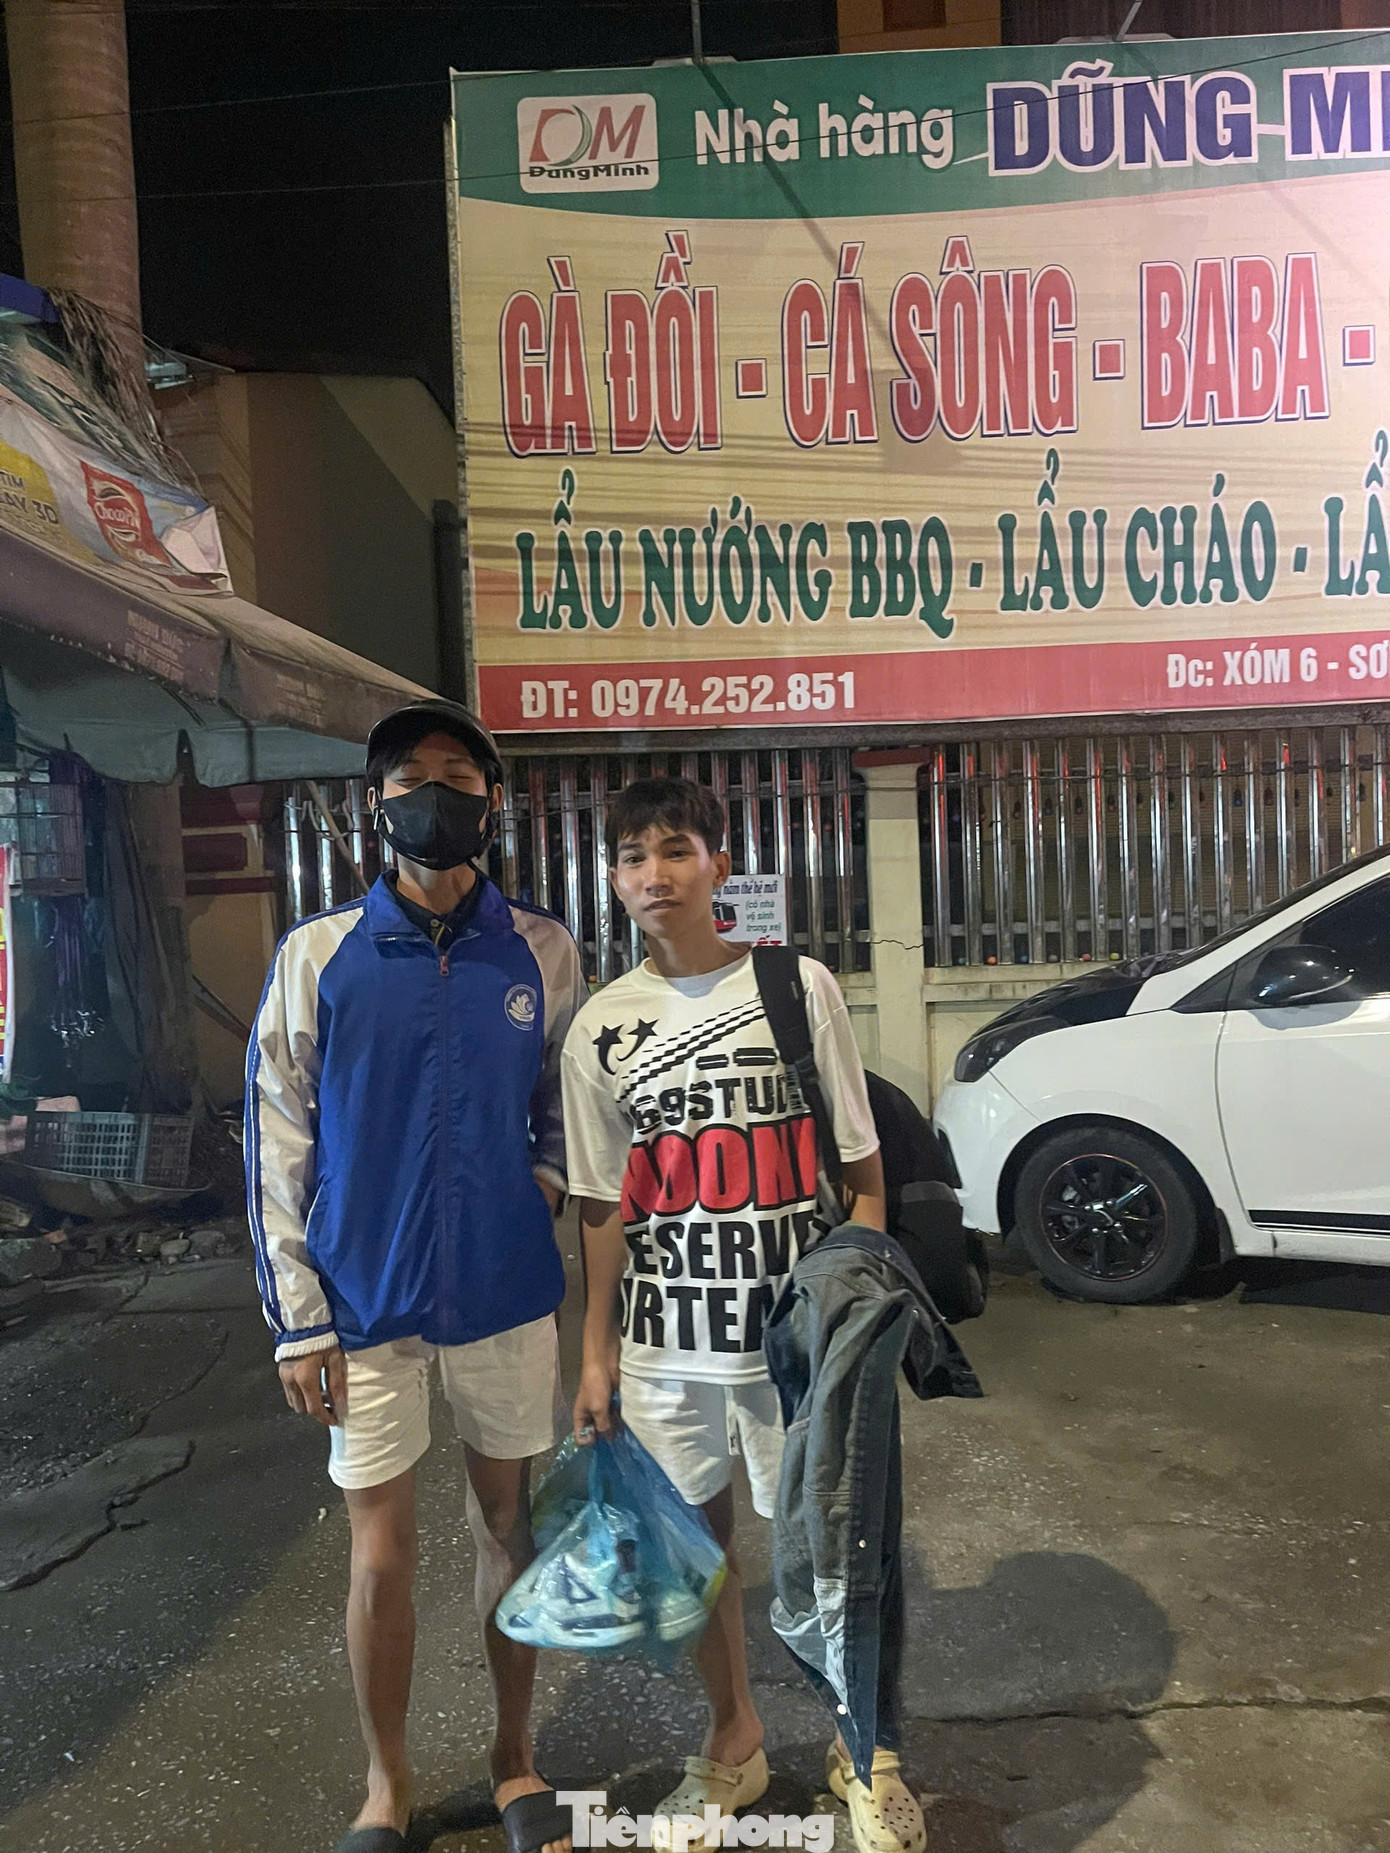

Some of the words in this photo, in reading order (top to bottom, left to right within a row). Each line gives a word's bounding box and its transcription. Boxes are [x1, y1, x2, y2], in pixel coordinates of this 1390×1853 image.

[694, 99, 800, 166] Nhà
[818, 94, 953, 169] hàng
[987, 59, 1258, 176] DŨNG
[501, 255, 597, 458] GÀ
[604, 229, 723, 454] ĐỒI
[781, 241, 879, 448] CÁ
[890, 235, 1078, 443] SÔNG
[1141, 252, 1330, 430] BABA
[515, 468, 624, 630] LẨU
[638, 495, 833, 627] NƯỚNG
[846, 516, 955, 639] BBQ
[998, 447, 1107, 612] LẨU
[1124, 472, 1277, 608] CHÁO
[520, 680, 578, 719] ĐT:
[591, 671, 855, 718] 0974.252.851
[1166, 653, 1214, 689] Đc:
[1222, 642, 1291, 686] XÓM
[1300, 647, 1318, 682] 6
[624, 1211, 817, 1280] ESERV
